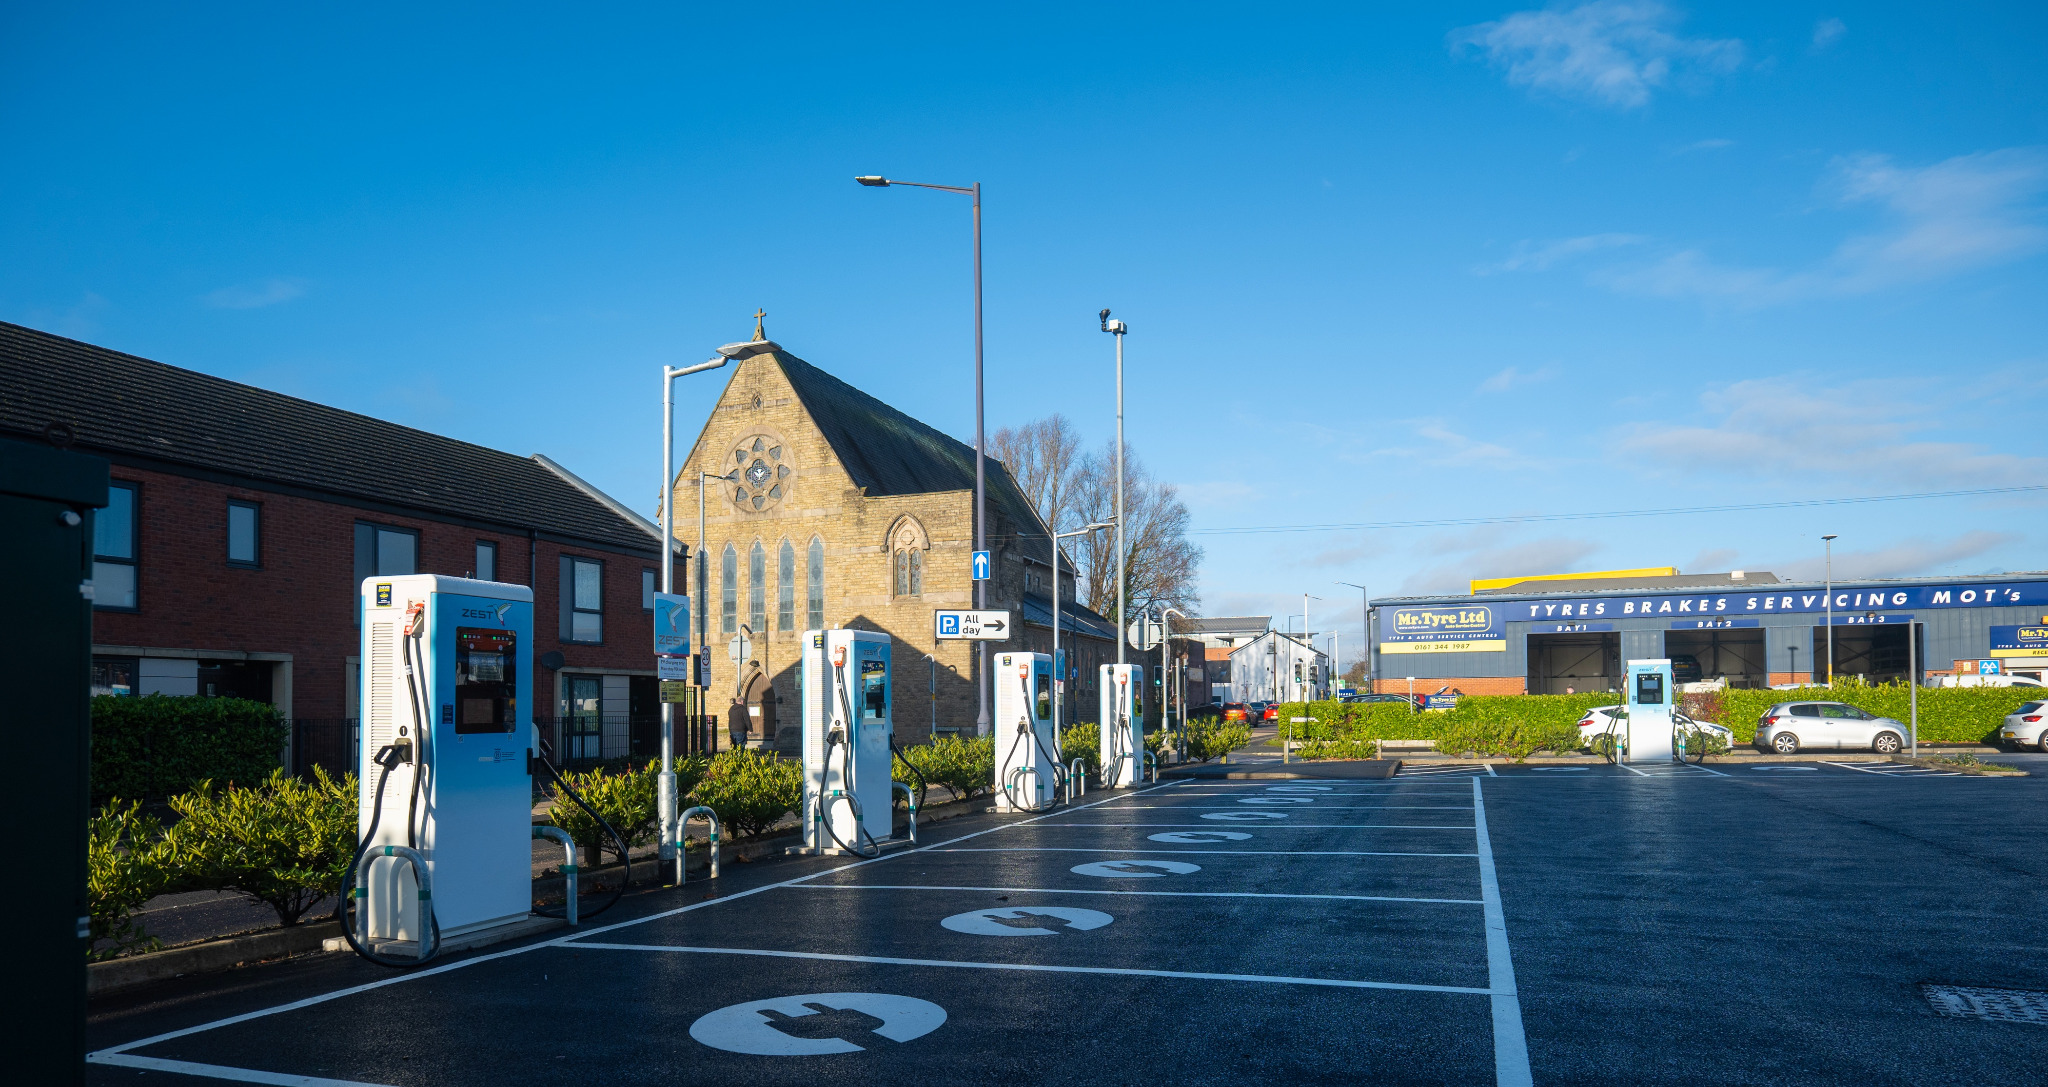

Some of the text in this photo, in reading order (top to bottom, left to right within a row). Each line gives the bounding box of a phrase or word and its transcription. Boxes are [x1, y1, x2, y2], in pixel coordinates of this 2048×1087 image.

[1530, 588, 2021, 617] TYRES BRAKES SERVICING MOT's
[461, 608, 494, 620] ZEST
[964, 614, 979, 623] All
[1459, 610, 1486, 624] Ltd
[942, 616, 955, 633] P
[962, 626, 981, 636] day
[658, 635, 687, 647] ZEST
[702, 653, 709, 661] 20
